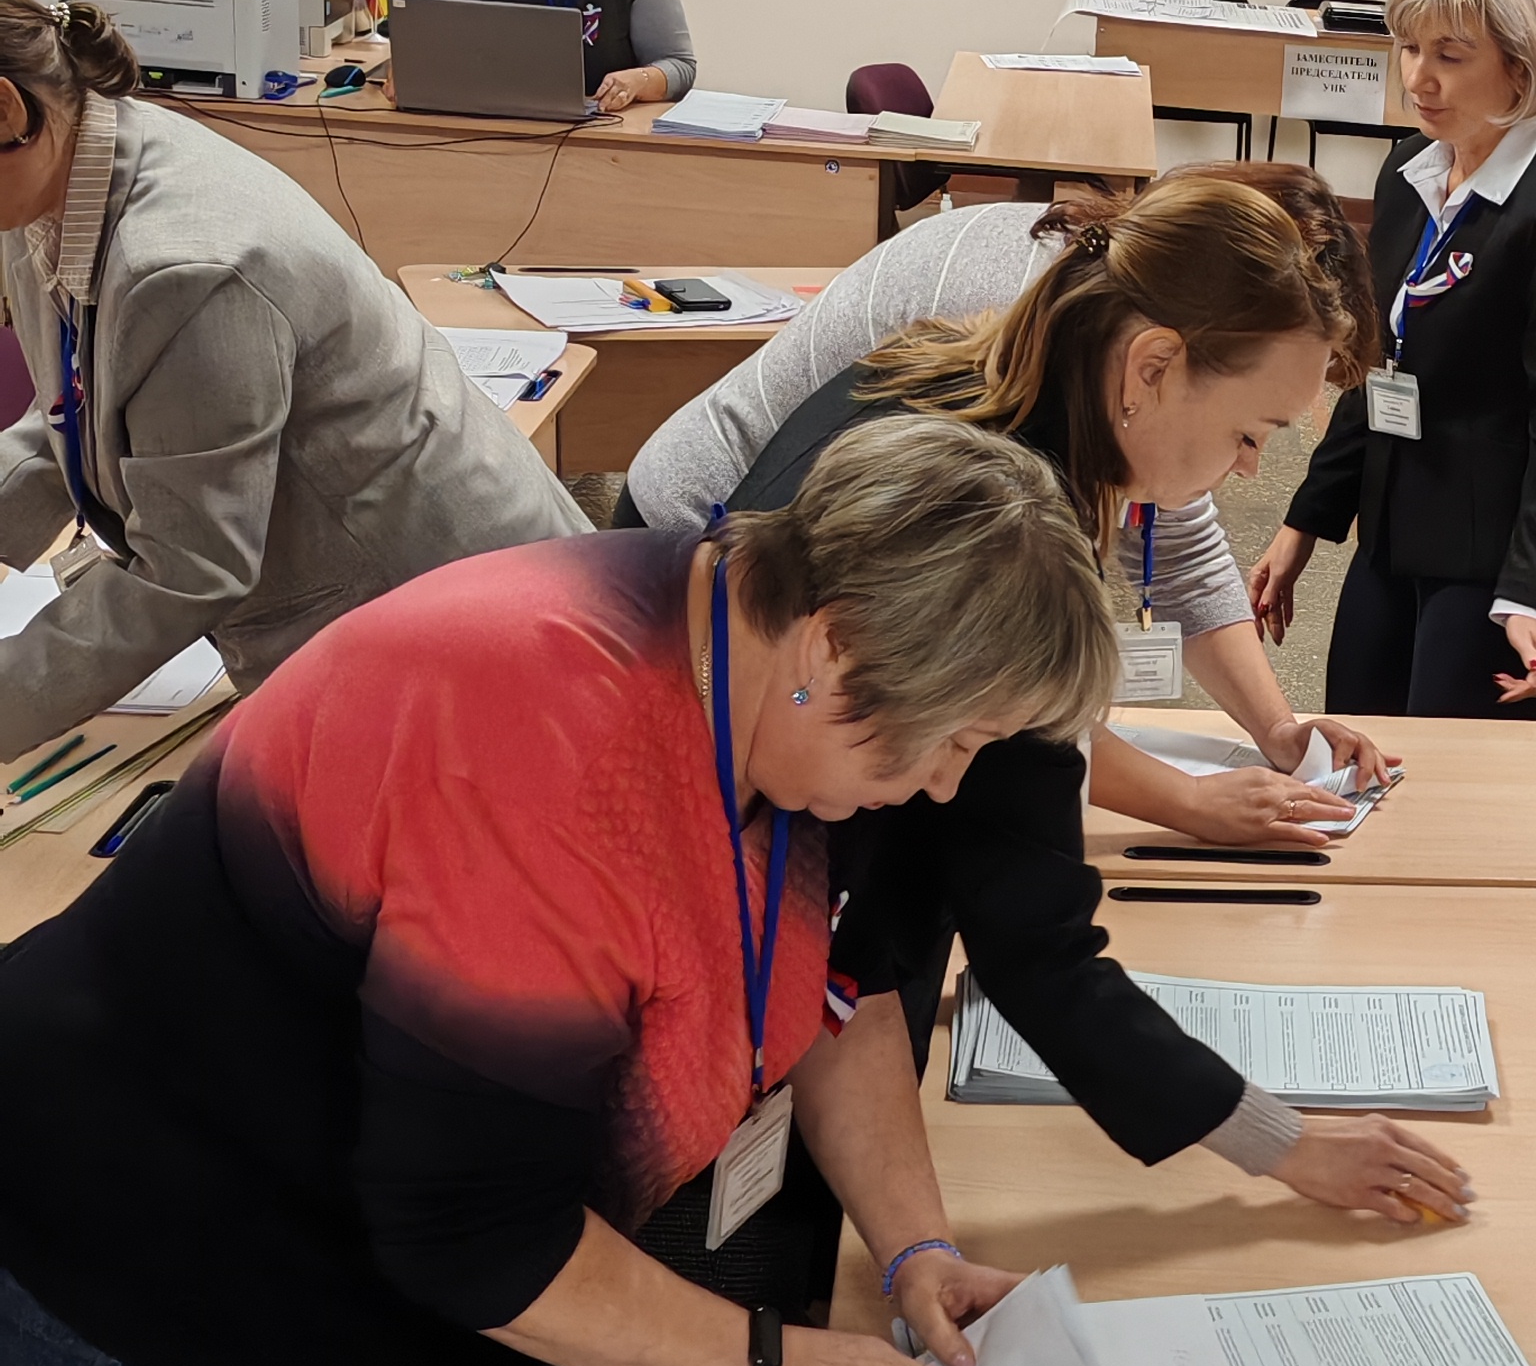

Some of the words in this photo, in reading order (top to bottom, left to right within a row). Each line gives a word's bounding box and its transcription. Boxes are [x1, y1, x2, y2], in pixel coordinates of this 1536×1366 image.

[1296, 52, 1377, 68] ЗАМЕСТИТЕЛЬ
[1291, 66, 1379, 82] ПРЕДСЕДАТЕЛЯ
[1323, 82, 1346, 94] УИК
